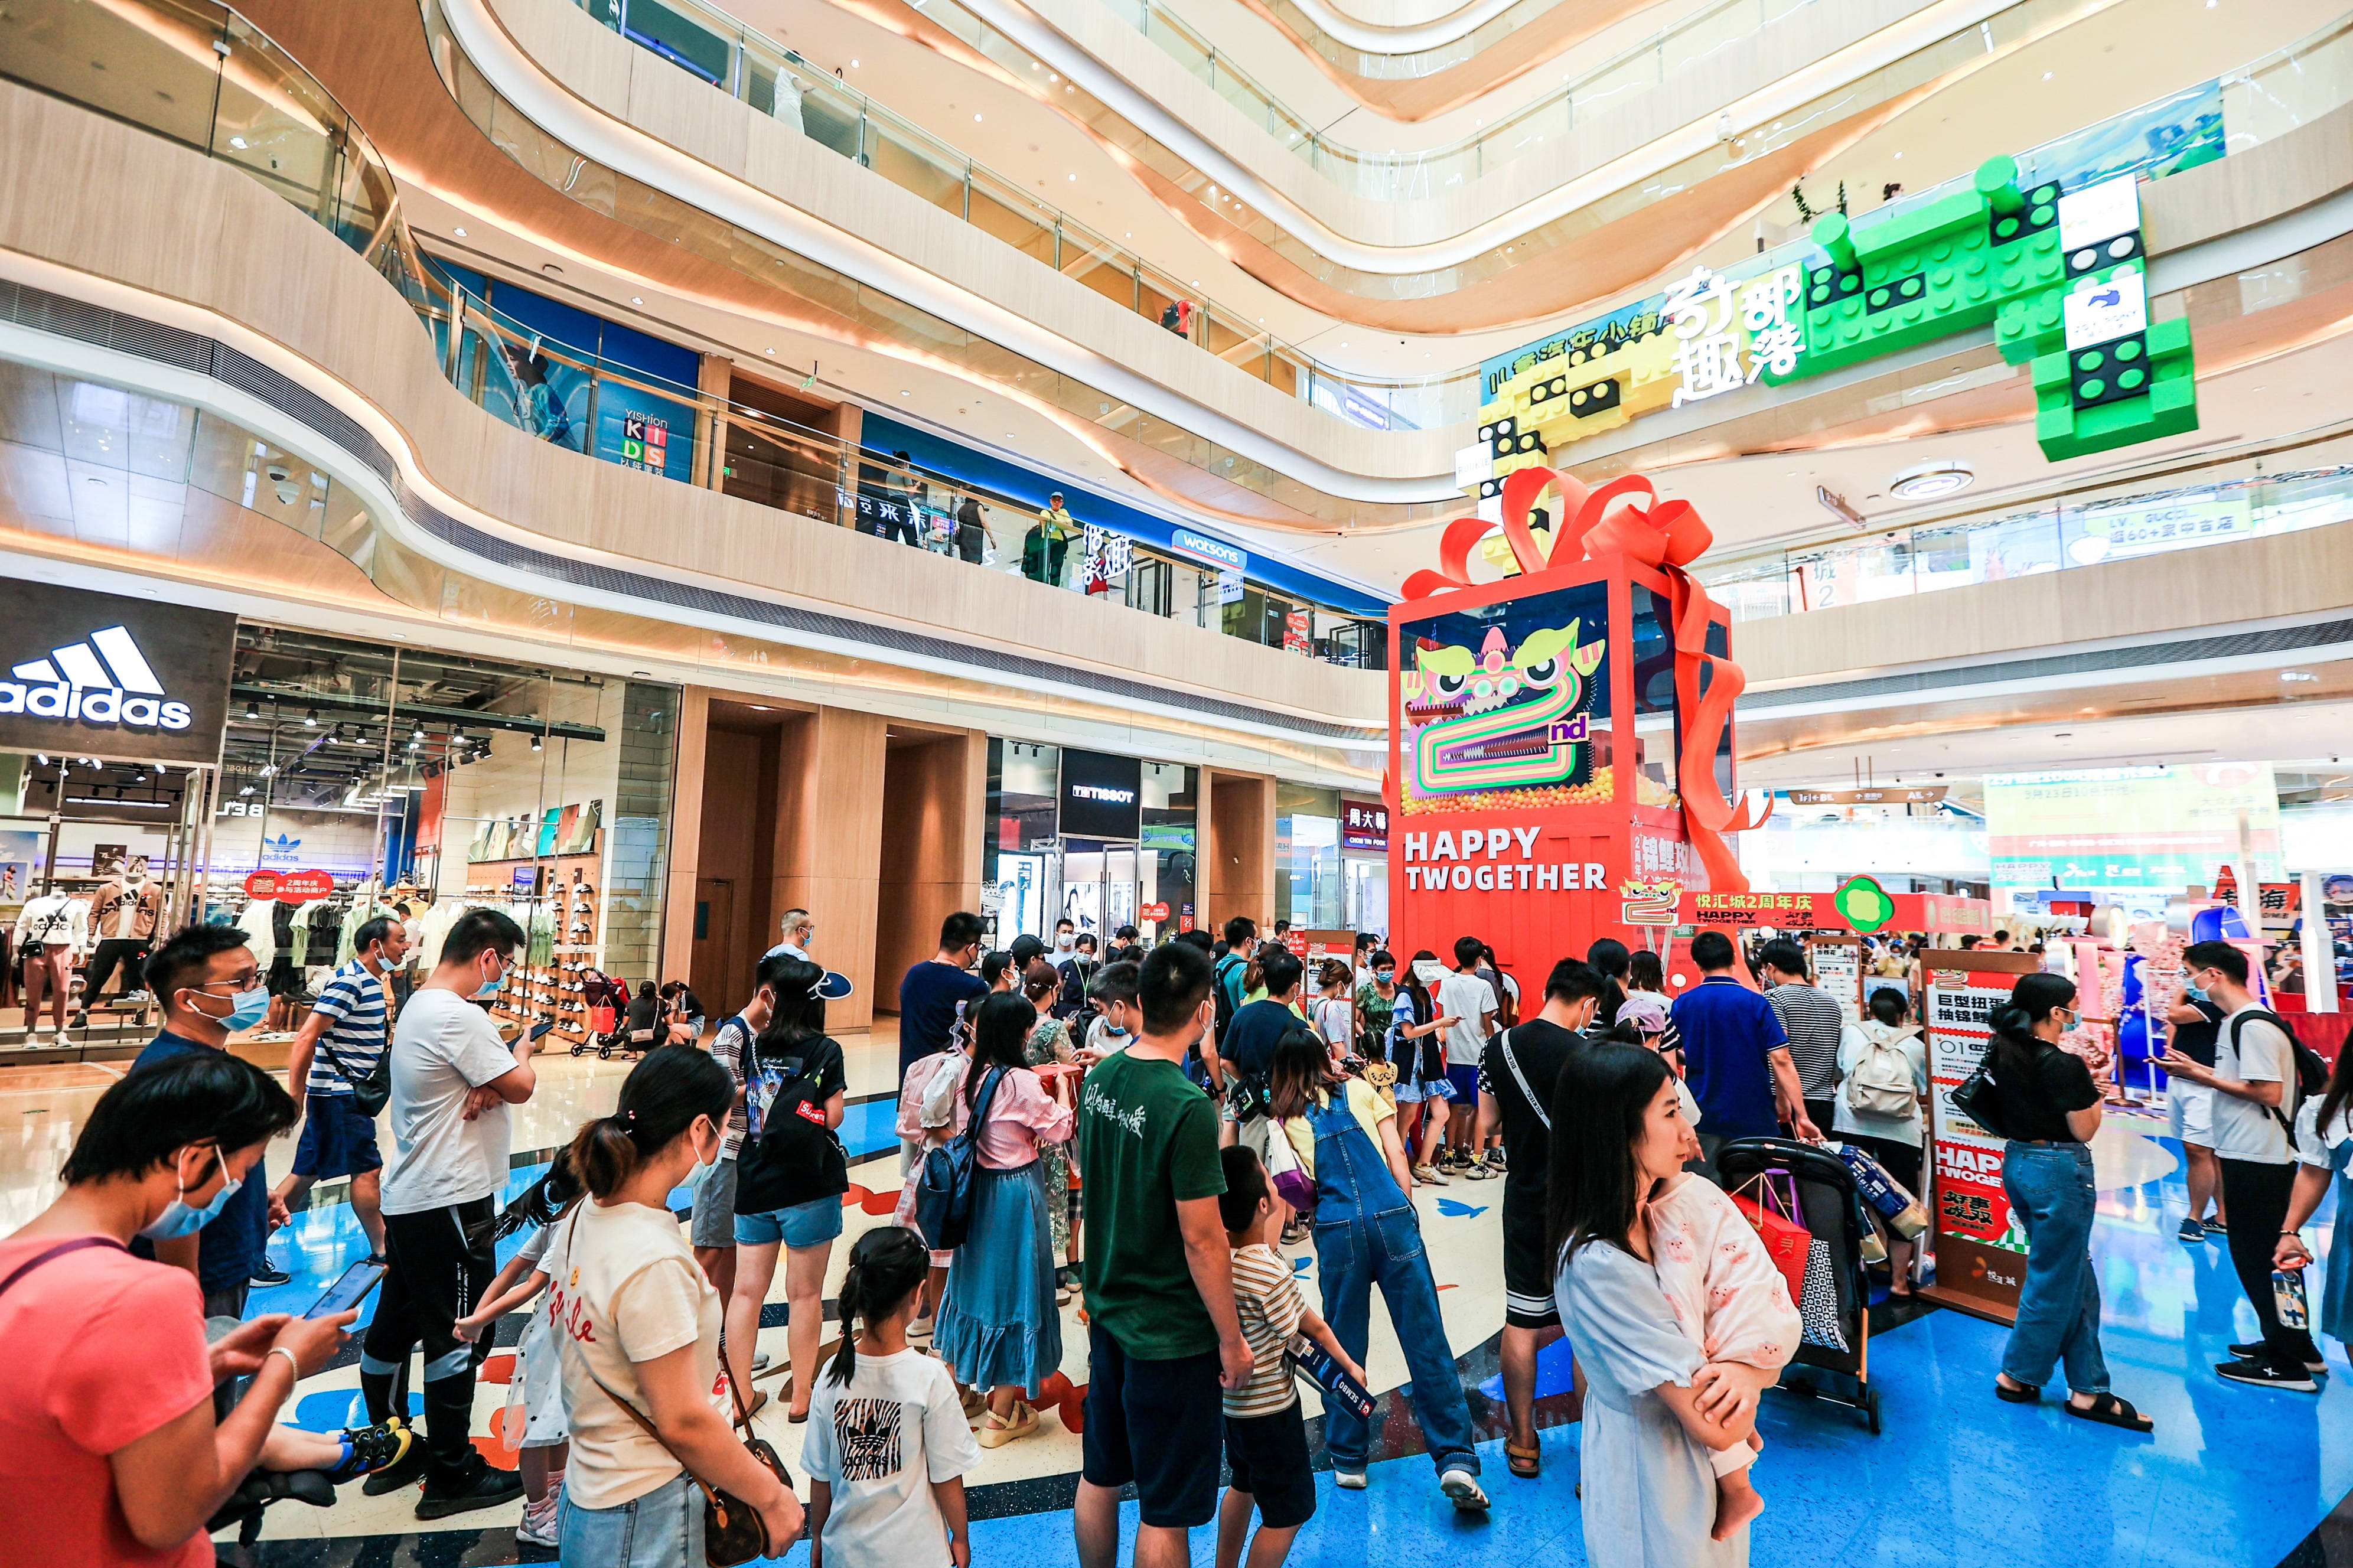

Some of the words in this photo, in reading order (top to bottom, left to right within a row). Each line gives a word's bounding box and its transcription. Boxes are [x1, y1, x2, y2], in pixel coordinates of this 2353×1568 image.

[1183, 534, 1239, 563] watsons
[0, 681, 191, 730] adidas
[1551, 714, 1586, 742] nd
[1090, 787, 1134, 803] TISSOT
[1350, 808, 1386, 829] 周大福
[1404, 827, 1541, 861] HAPPY
[262, 853, 299, 862] adidas
[1406, 863, 1607, 891] TWOGETHER
[1696, 894, 1813, 910] 悦汇城2周年庆
[1697, 911, 1755, 920] HAPPY
[1527, 1093, 1544, 1116] DICKIES
[1935, 1145, 2003, 1173] HAP
[1339, 1381, 1359, 1403] SEMBO
